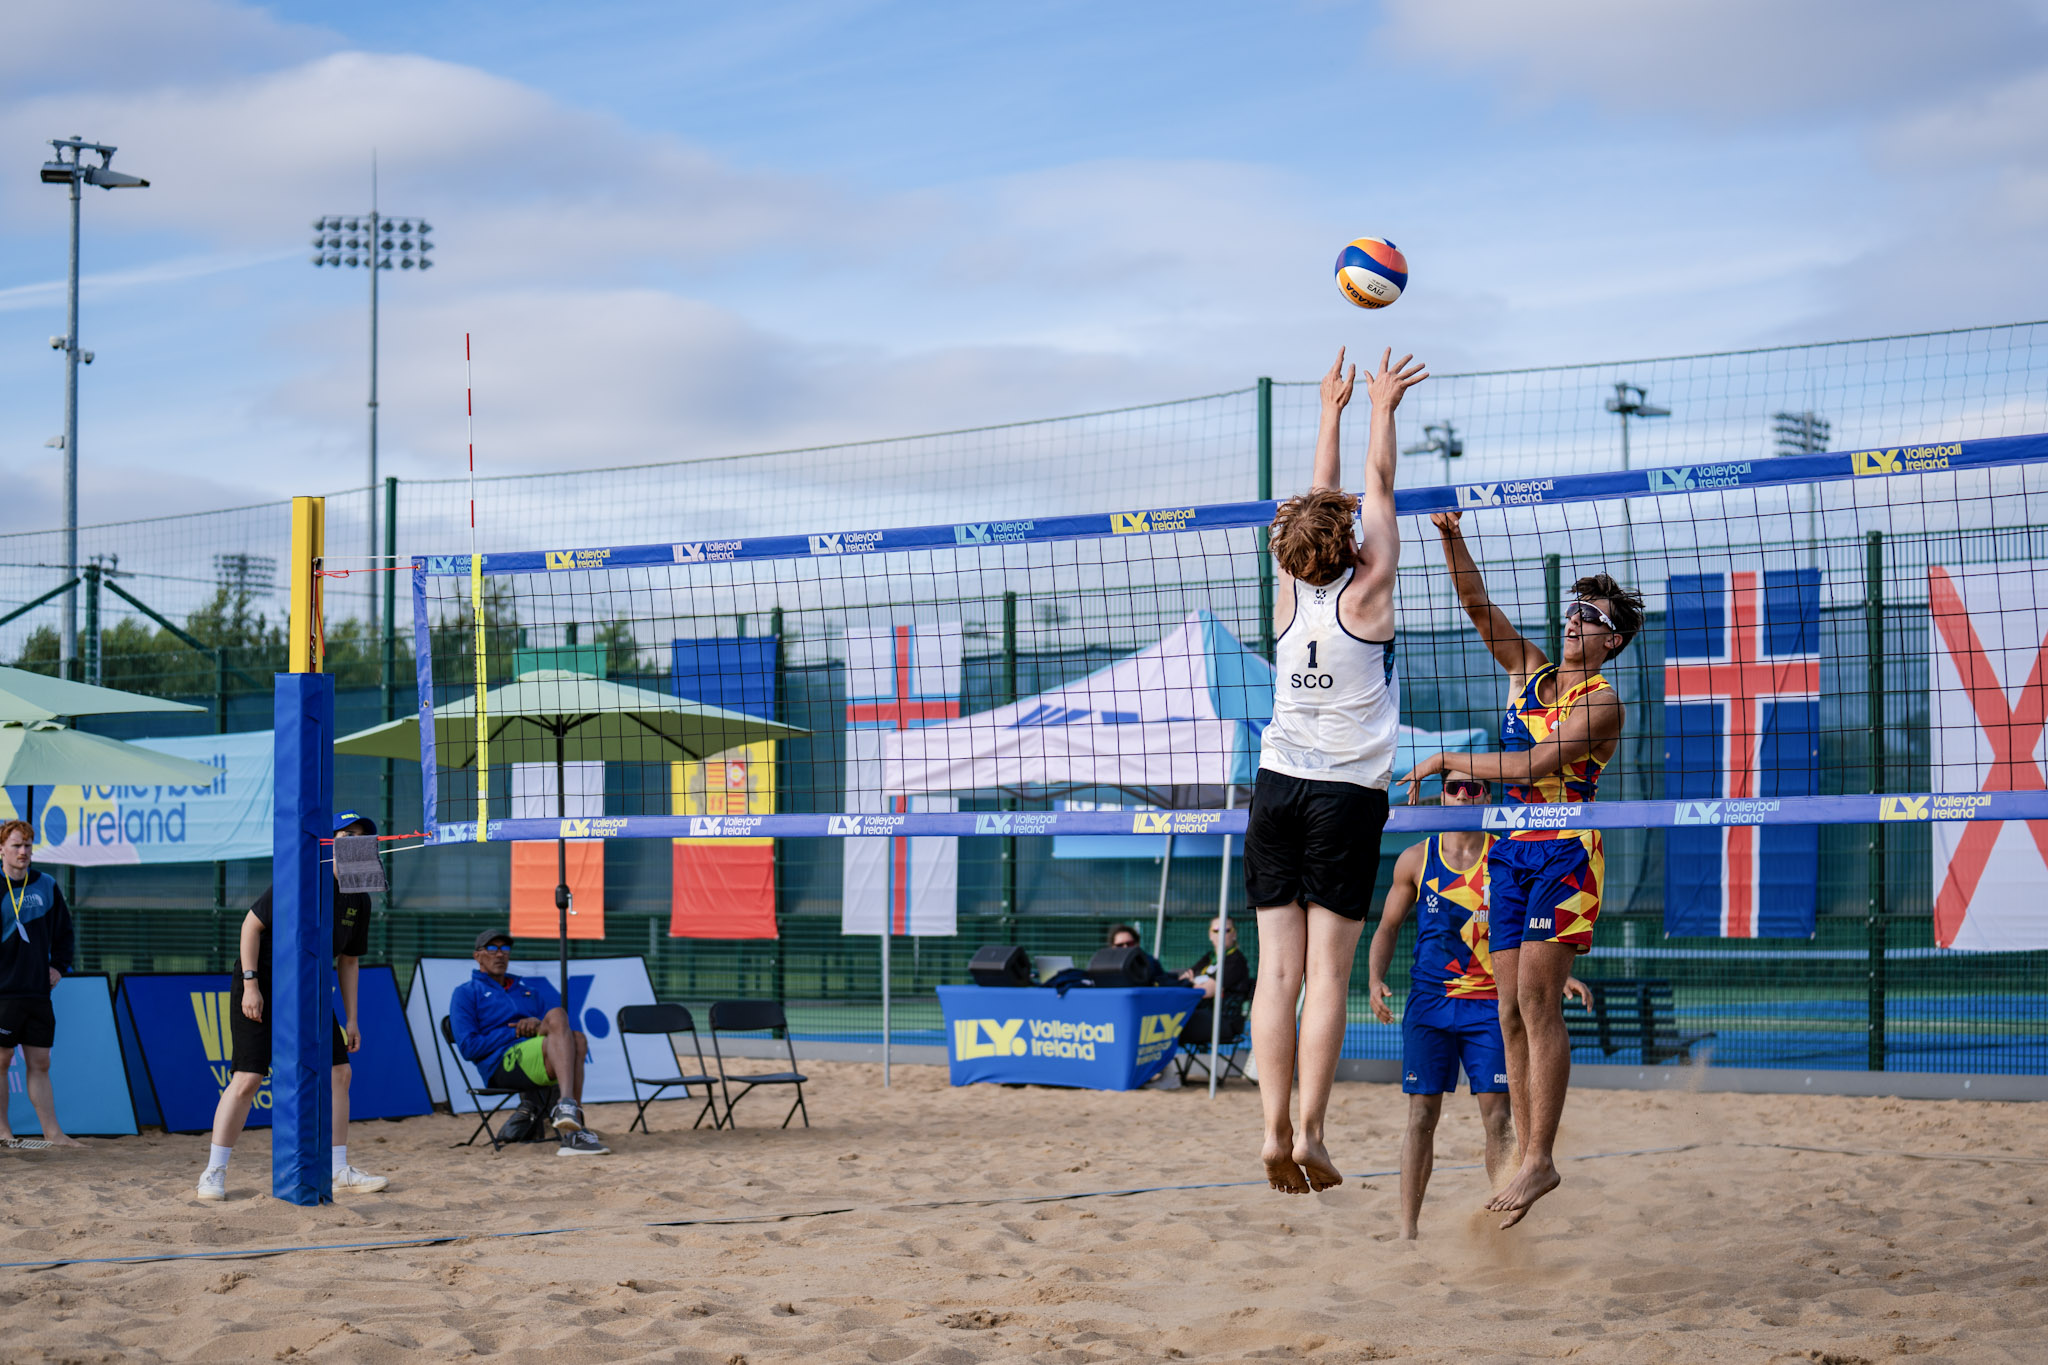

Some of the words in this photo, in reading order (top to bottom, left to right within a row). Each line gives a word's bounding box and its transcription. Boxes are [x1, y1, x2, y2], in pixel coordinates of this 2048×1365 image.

[1903, 443, 1962, 460] Volleyball
[1906, 457, 1949, 471] Ireland
[1696, 463, 1751, 478] Volleyball
[1501, 480, 1553, 494] Volleyball
[1698, 475, 1739, 489] Ireland
[1504, 491, 1542, 504] Ireland
[1150, 508, 1195, 522] Volleyball
[991, 521, 1034, 533] Volleyball
[1152, 520, 1185, 532] Ireland
[843, 532, 883, 544] Volleyball
[994, 531, 1025, 542] Ireland
[705, 541, 742, 553] Volleyball
[845, 542, 874, 552] Ireland
[575, 549, 610, 561] Volleyball
[706, 551, 735, 561] Ireland
[576, 559, 602, 568] Ireland
[1307, 641, 1318, 668] 1
[1291, 674, 1334, 689] SCO
[1725, 800, 1780, 812] Volleyball
[1933, 794, 1991, 808] Volleyball
[1529, 805, 1581, 818] Volleyball
[1931, 807, 1975, 819] Ireland
[79, 801, 186, 846] Ireland
[592, 817, 628, 828] Volleyball
[724, 816, 762, 827] Volleyball
[865, 815, 904, 826] Volleyball
[1015, 814, 1057, 825] Volleyball
[1175, 813, 1220, 824] Volleyball
[1528, 816, 1567, 828] Ireland
[1723, 812, 1765, 824] Ireland
[591, 827, 617, 837] Ireland
[723, 826, 751, 835] Ireland
[863, 825, 893, 835] Ireland
[1013, 824, 1045, 834] Ireland
[1174, 823, 1207, 833] Ireland
[1529, 917, 1552, 929] ALAN
[1028, 1019, 1115, 1043] Volleyball
[1031, 1038, 1096, 1061] Ireland
[1494, 1073, 1507, 1084] CRI
